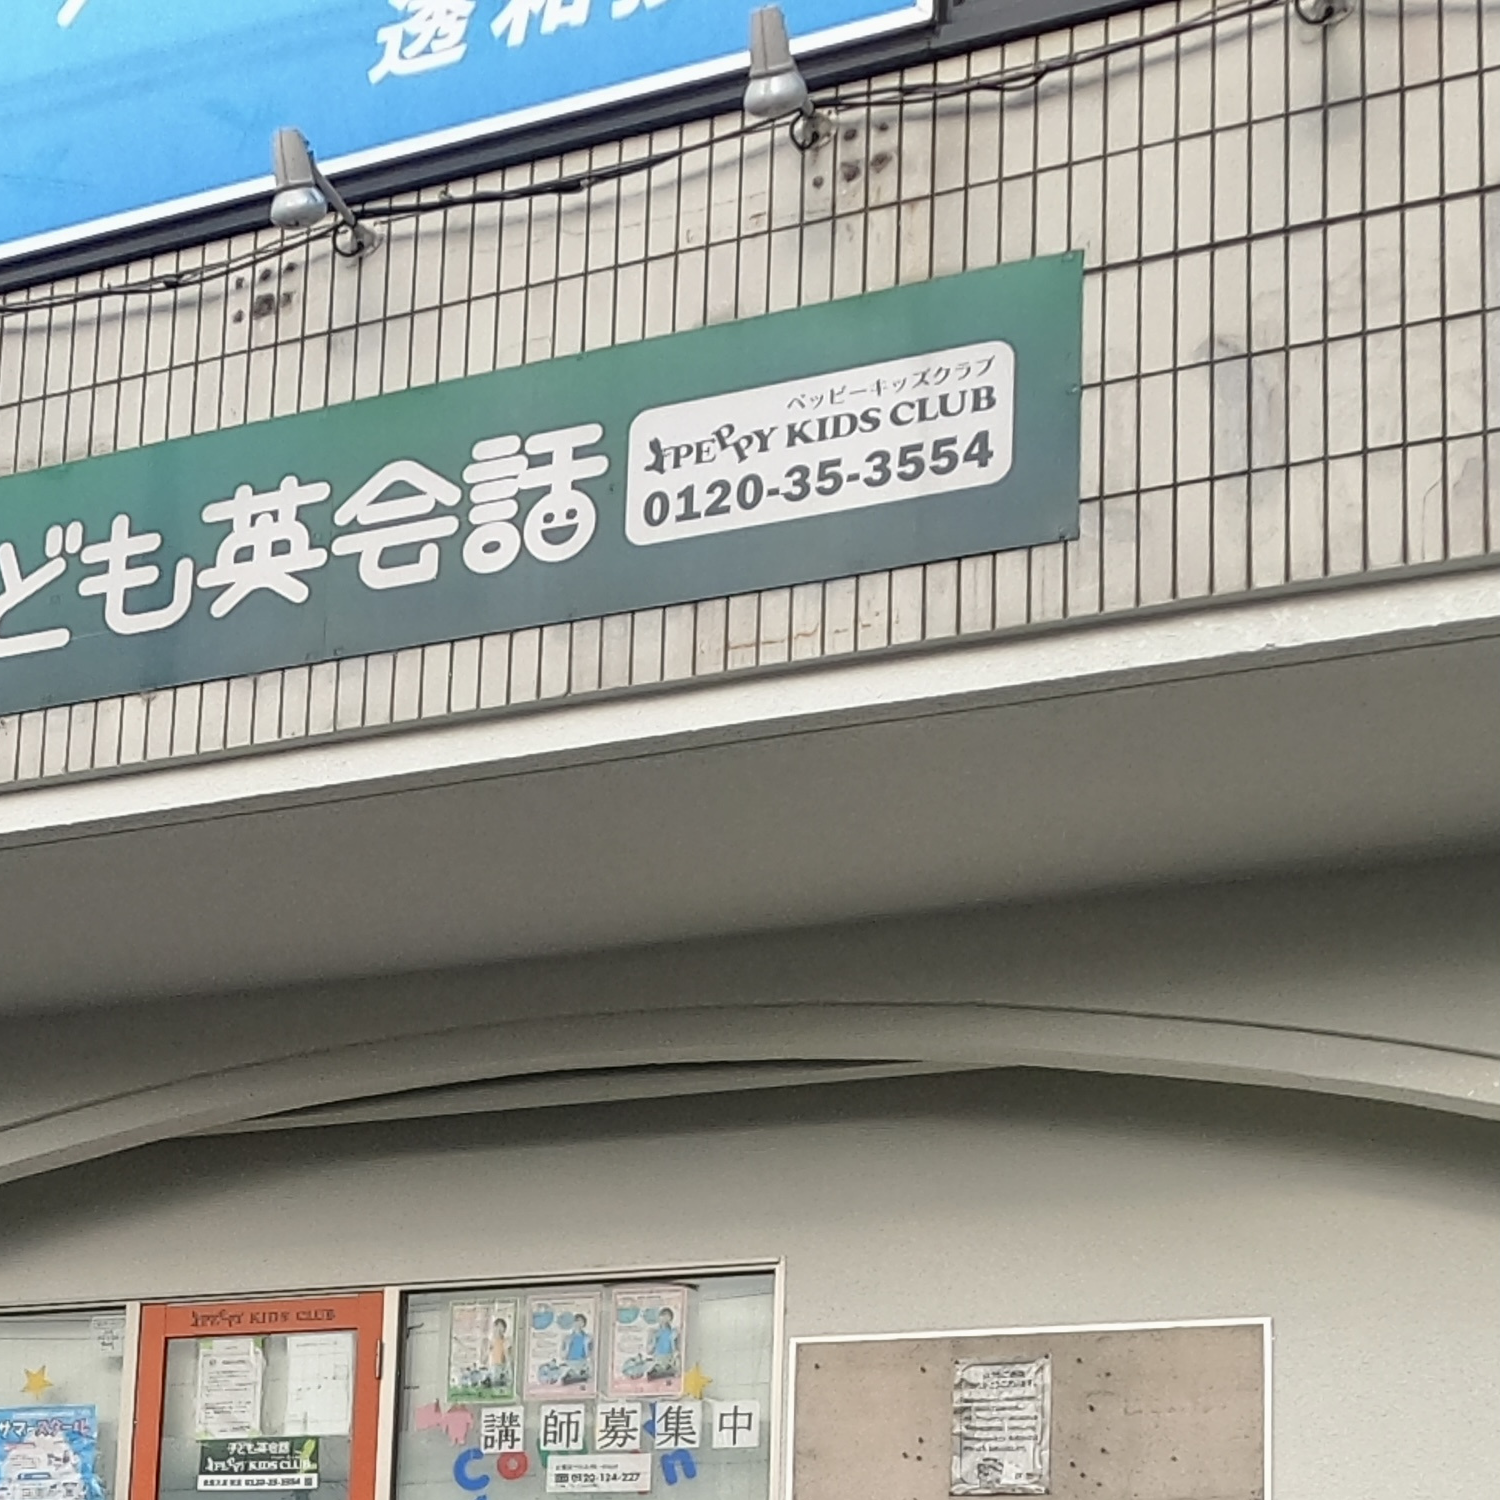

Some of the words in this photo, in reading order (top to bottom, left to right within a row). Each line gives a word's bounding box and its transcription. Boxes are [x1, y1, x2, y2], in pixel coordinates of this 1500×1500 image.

[664, 422, 778, 465] PEPPY
[786, 406, 881, 448] KIDS
[889, 385, 997, 428] CLUB
[643, 430, 994, 528] 0120-35-3554
[482, 1403, 754, 1450] 講師募集中
